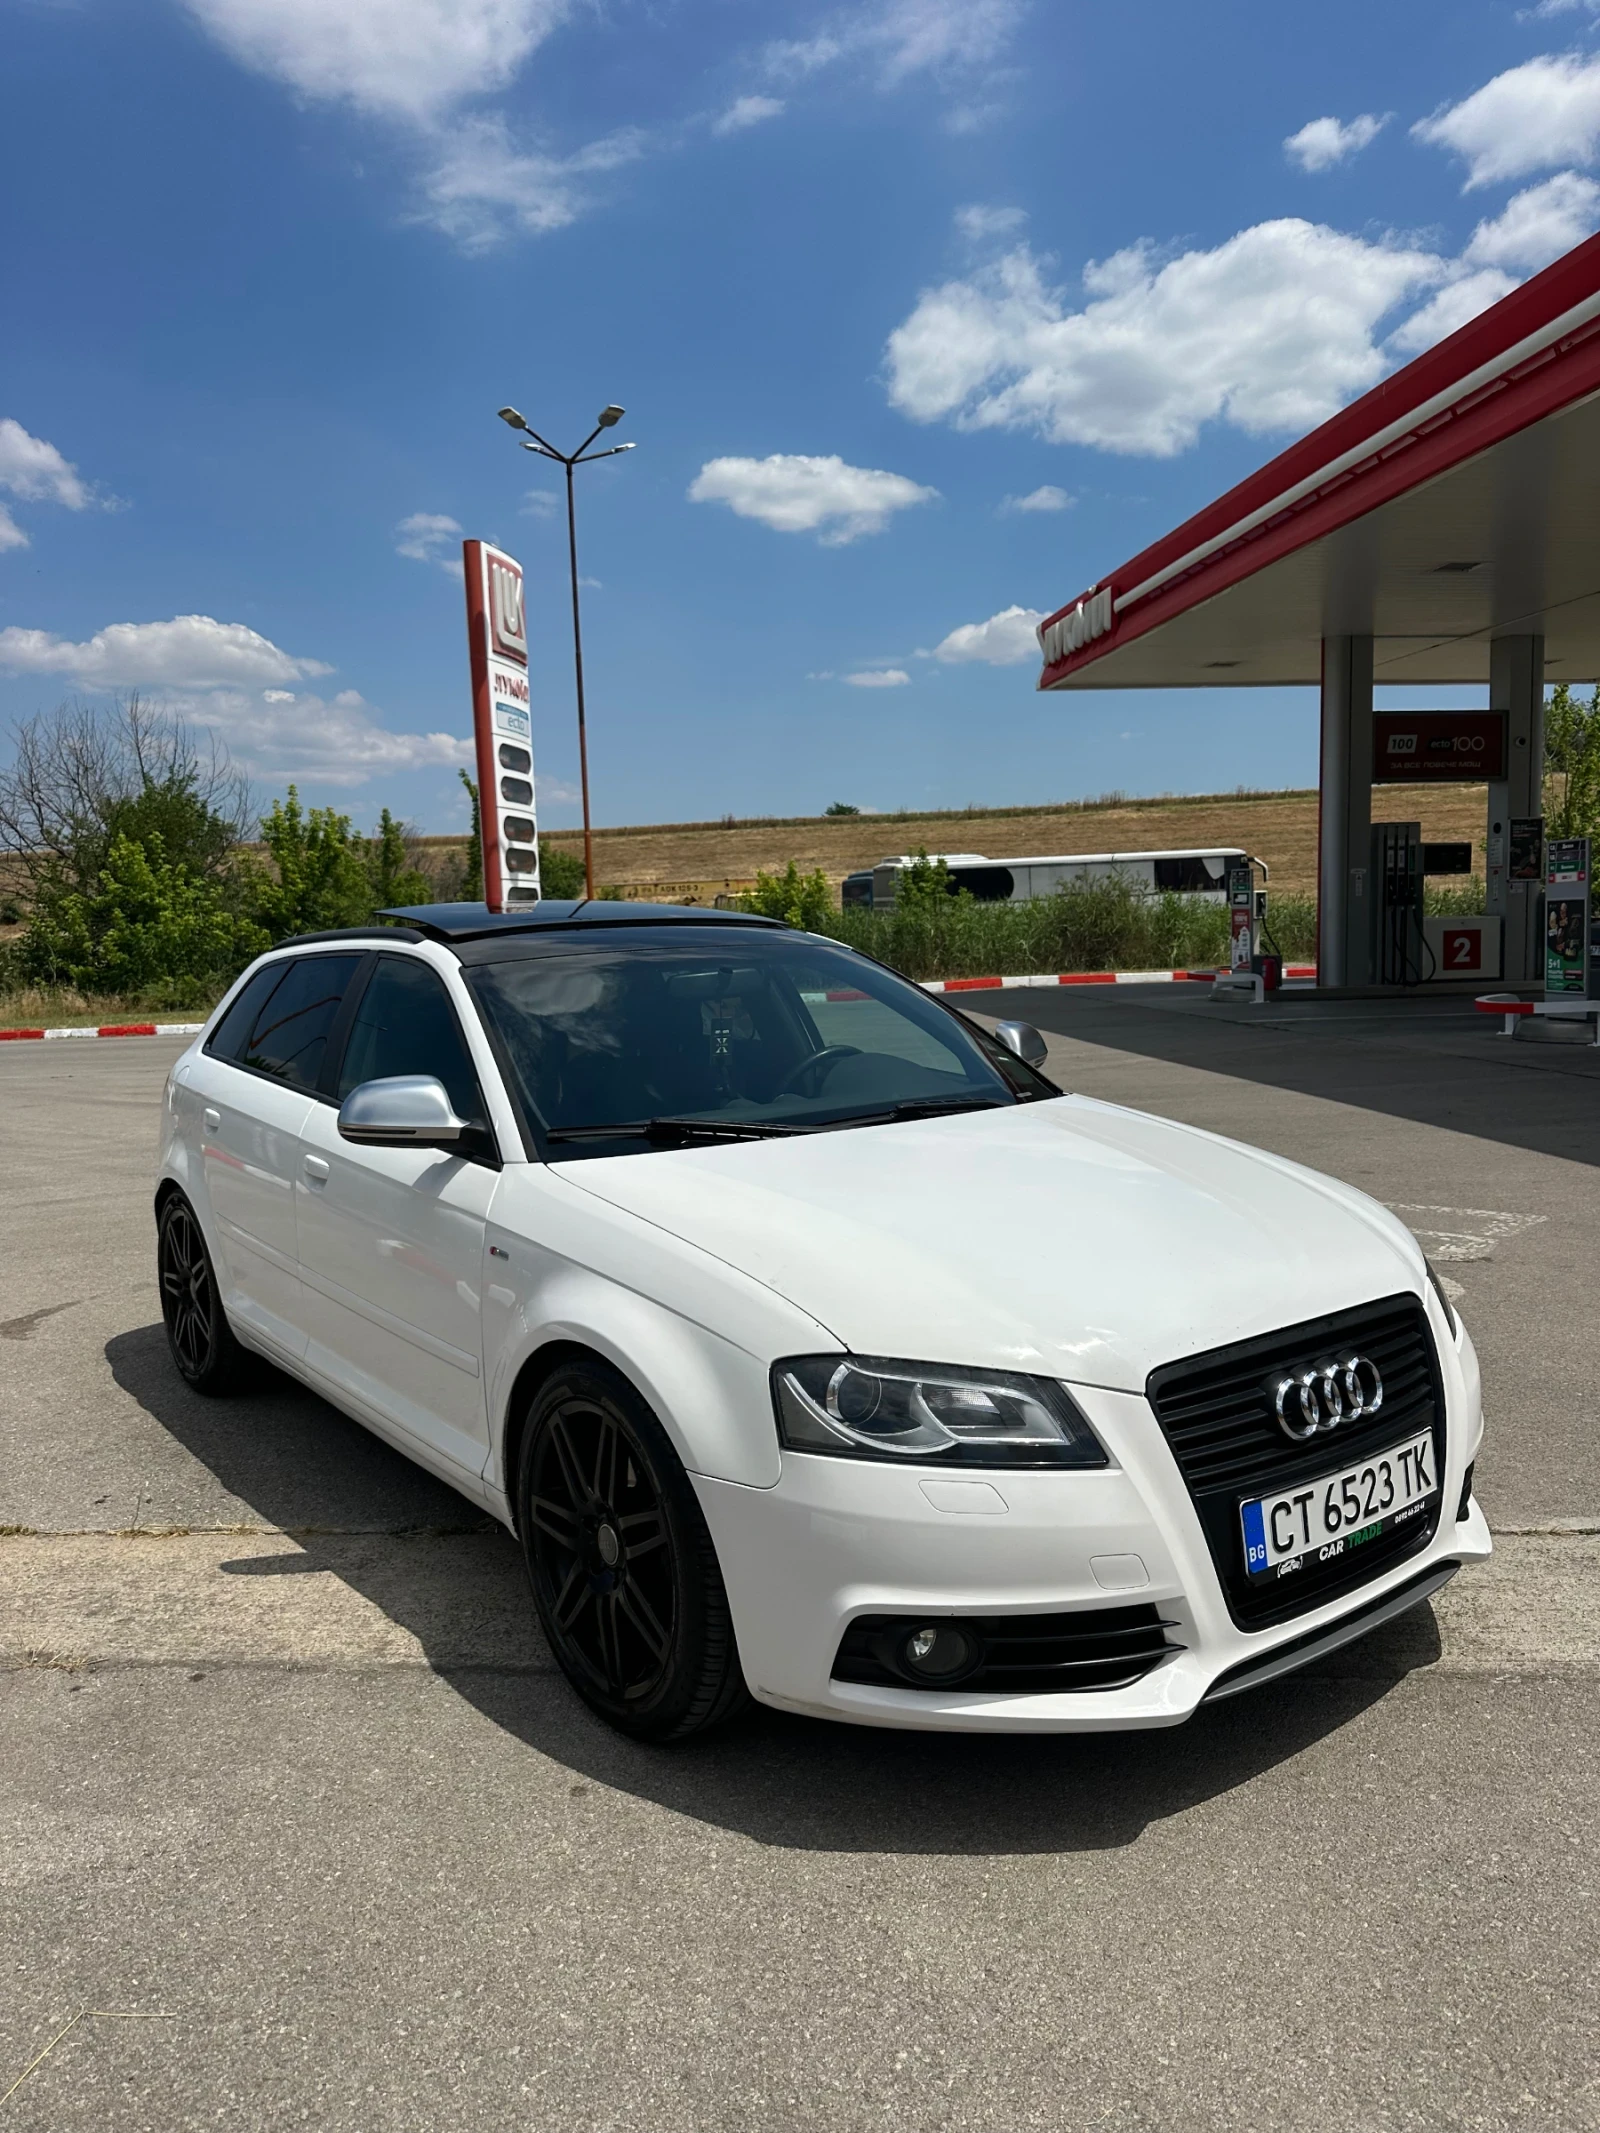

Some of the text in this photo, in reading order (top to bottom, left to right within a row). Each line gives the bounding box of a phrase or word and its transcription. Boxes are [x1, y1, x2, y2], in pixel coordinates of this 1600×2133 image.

[1391, 738, 1414, 750] 100
[1452, 937, 1472, 963] 2
[1547, 958, 1561, 969] 5+1
[1270, 1440, 1432, 1554] CT 6523 TK
[1318, 1521, 1384, 1561] CAR TRADE
[1248, 1543, 1265, 1564] BG
